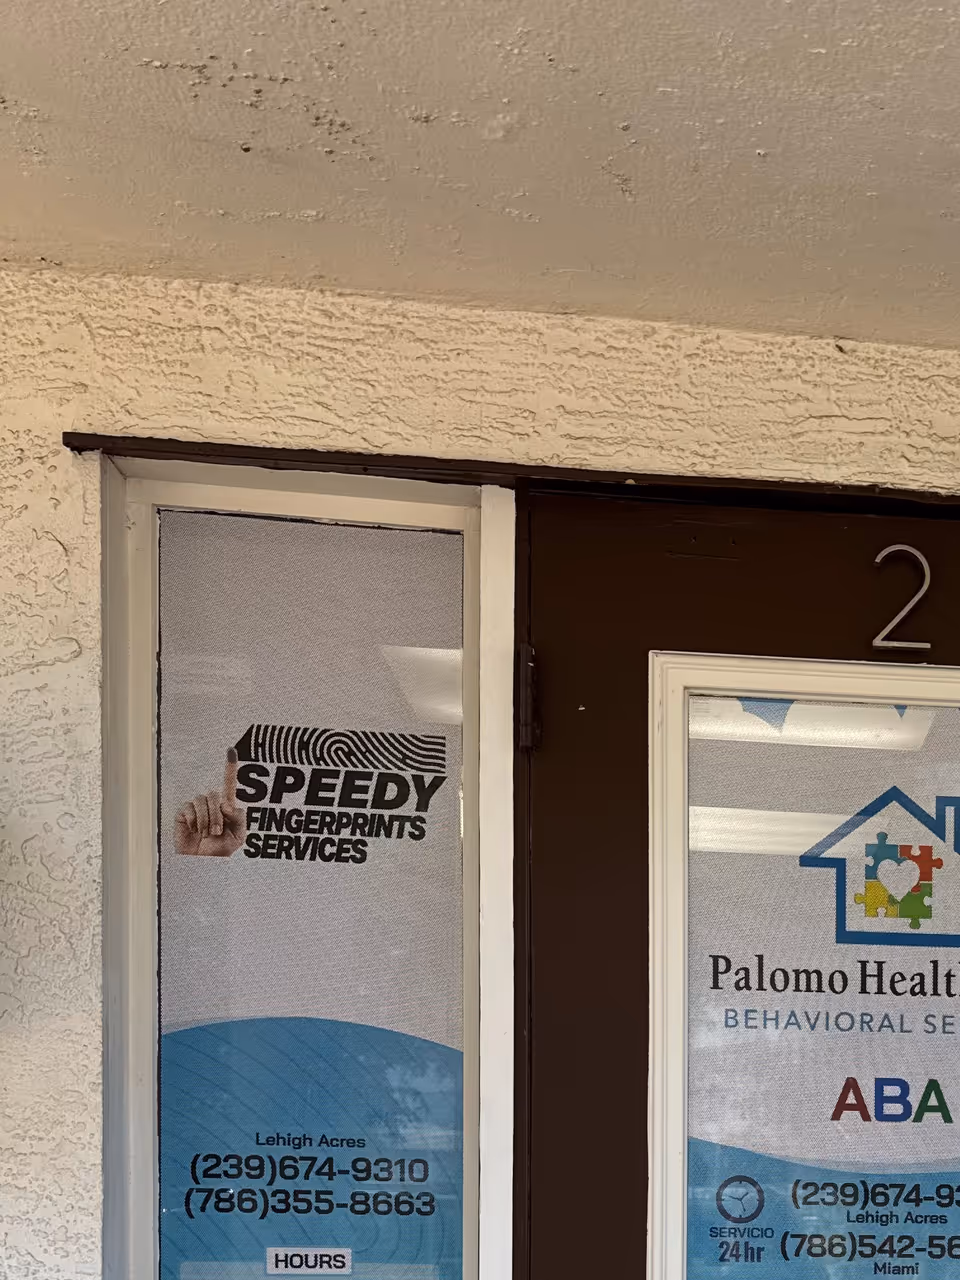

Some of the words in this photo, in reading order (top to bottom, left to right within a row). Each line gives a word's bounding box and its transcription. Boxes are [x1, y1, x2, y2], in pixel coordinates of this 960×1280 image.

[872, 543, 931, 648] 2
[235, 764, 447, 812] SPEEDY
[246, 806, 427, 841] FINGERPRINTS
[243, 833, 368, 864] SERVICES
[708, 954, 848, 994] Palomo
[724, 1008, 912, 1034] BEHAVIORAL
[830, 1076, 953, 1123] ABA
[255, 1132, 313, 1150] Lehigh
[318, 1133, 366, 1148] Acres
[190, 1153, 429, 1185] (239)674-9310
[184, 1187, 435, 1219] (786)355-8663
[846, 1210, 899, 1226] Lehigh
[904, 1212, 948, 1225] Acres
[709, 1227, 774, 1238] SERVICIO
[274, 1253, 346, 1269] HOURS
[873, 1262, 919, 1276] Miami
